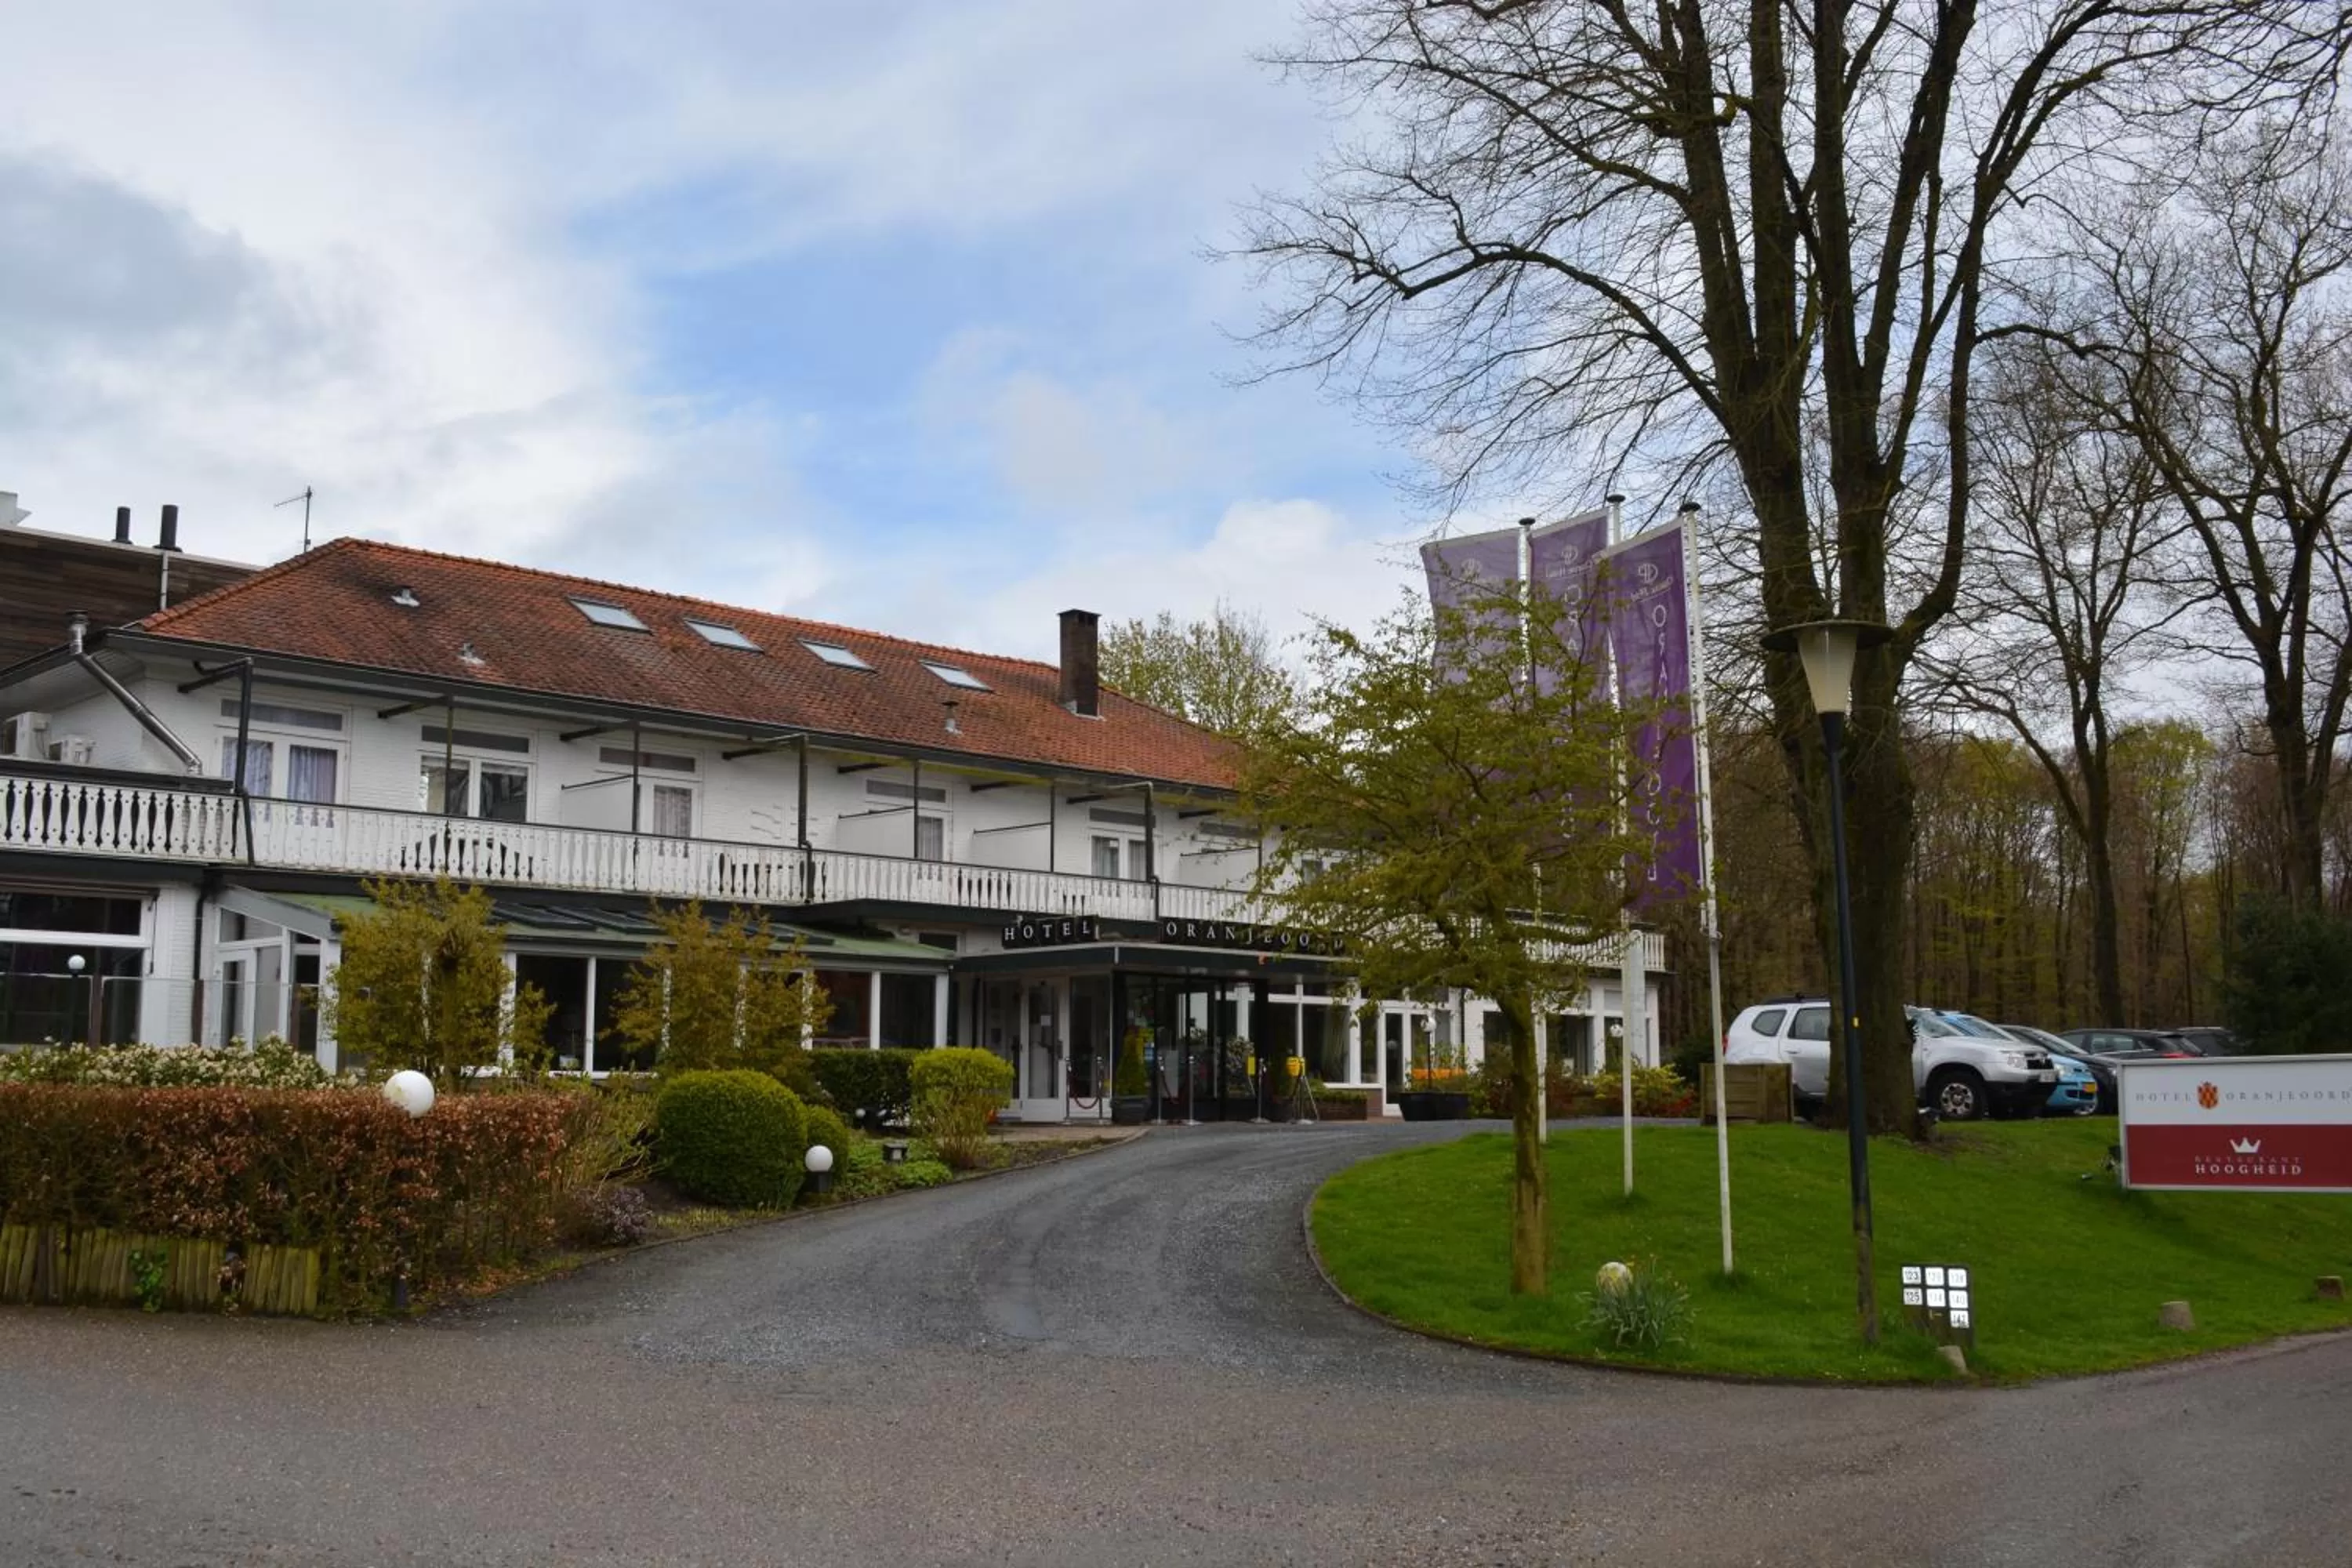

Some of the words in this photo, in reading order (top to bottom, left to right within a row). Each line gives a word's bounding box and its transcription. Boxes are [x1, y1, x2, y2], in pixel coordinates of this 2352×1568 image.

[1004, 921, 1091, 942] HOTEL
[1165, 921, 1344, 949] ORANJEOOD
[2135, 1092, 2191, 1102] HOTEL
[2225, 1090, 2351, 1102] ORANJEOORD
[2194, 1163, 2303, 1175] HOOGHEID
